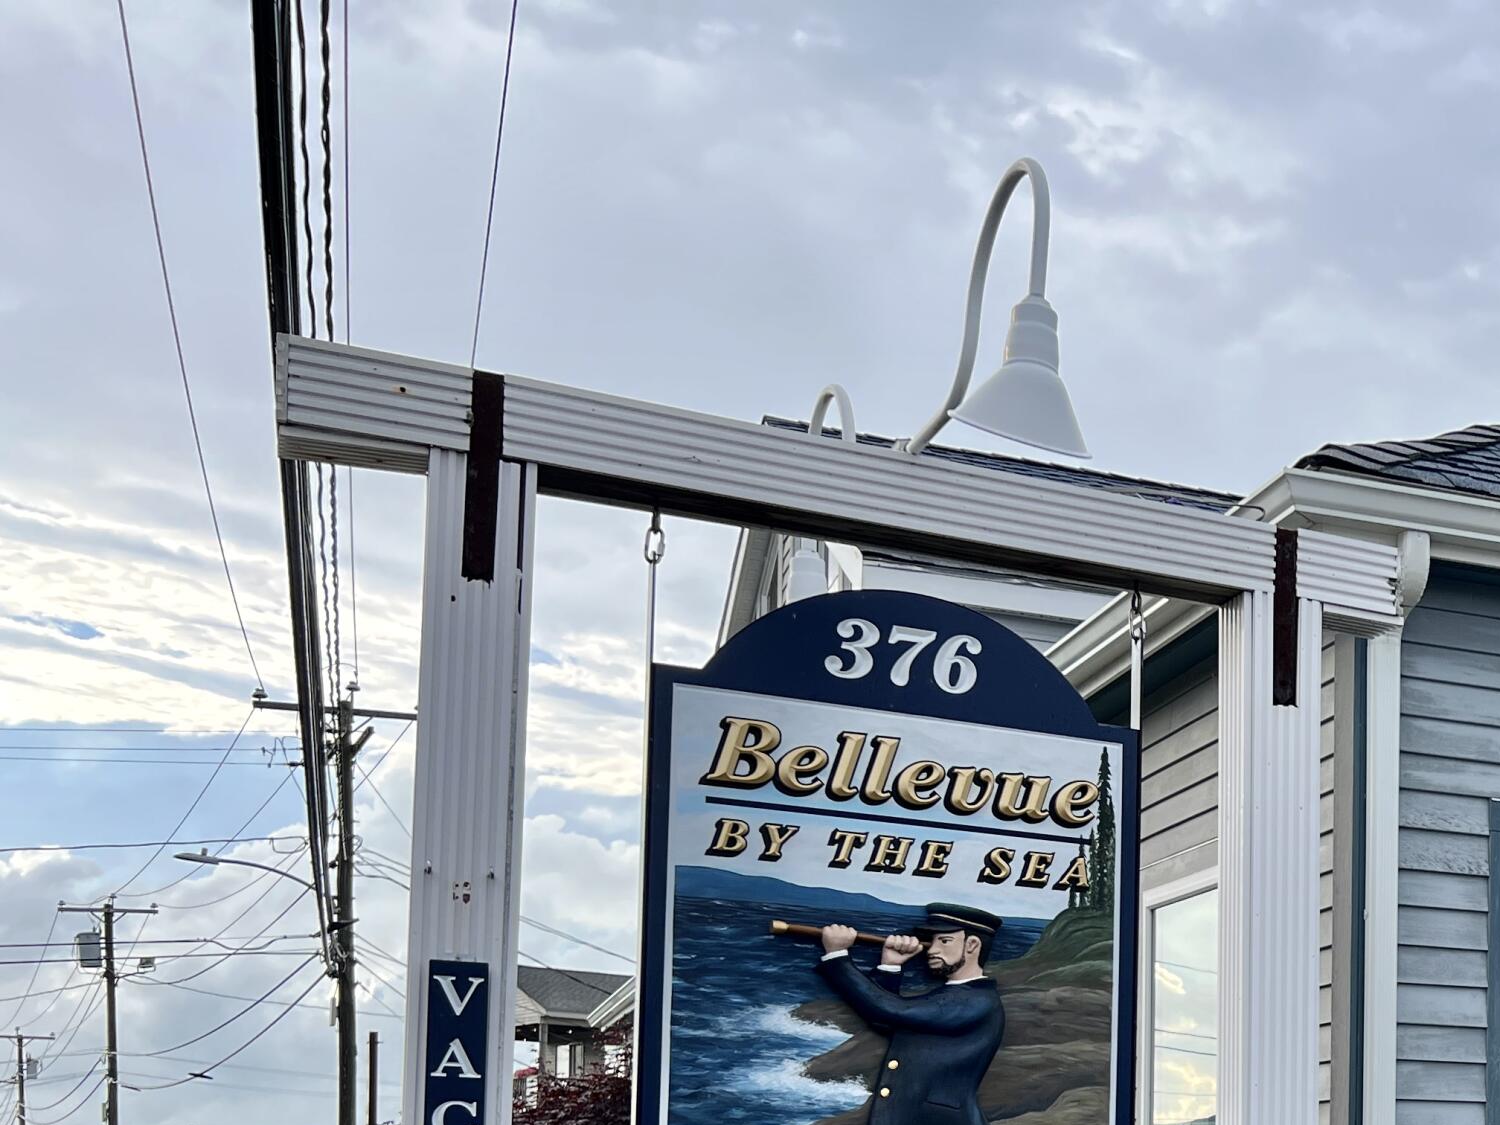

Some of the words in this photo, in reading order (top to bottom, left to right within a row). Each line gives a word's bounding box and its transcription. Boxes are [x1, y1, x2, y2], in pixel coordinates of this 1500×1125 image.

[824, 618, 983, 694] 376
[699, 715, 1100, 827] Bellevue
[706, 818, 799, 862] BY
[828, 828, 953, 878] THE
[978, 847, 1091, 891] SEA
